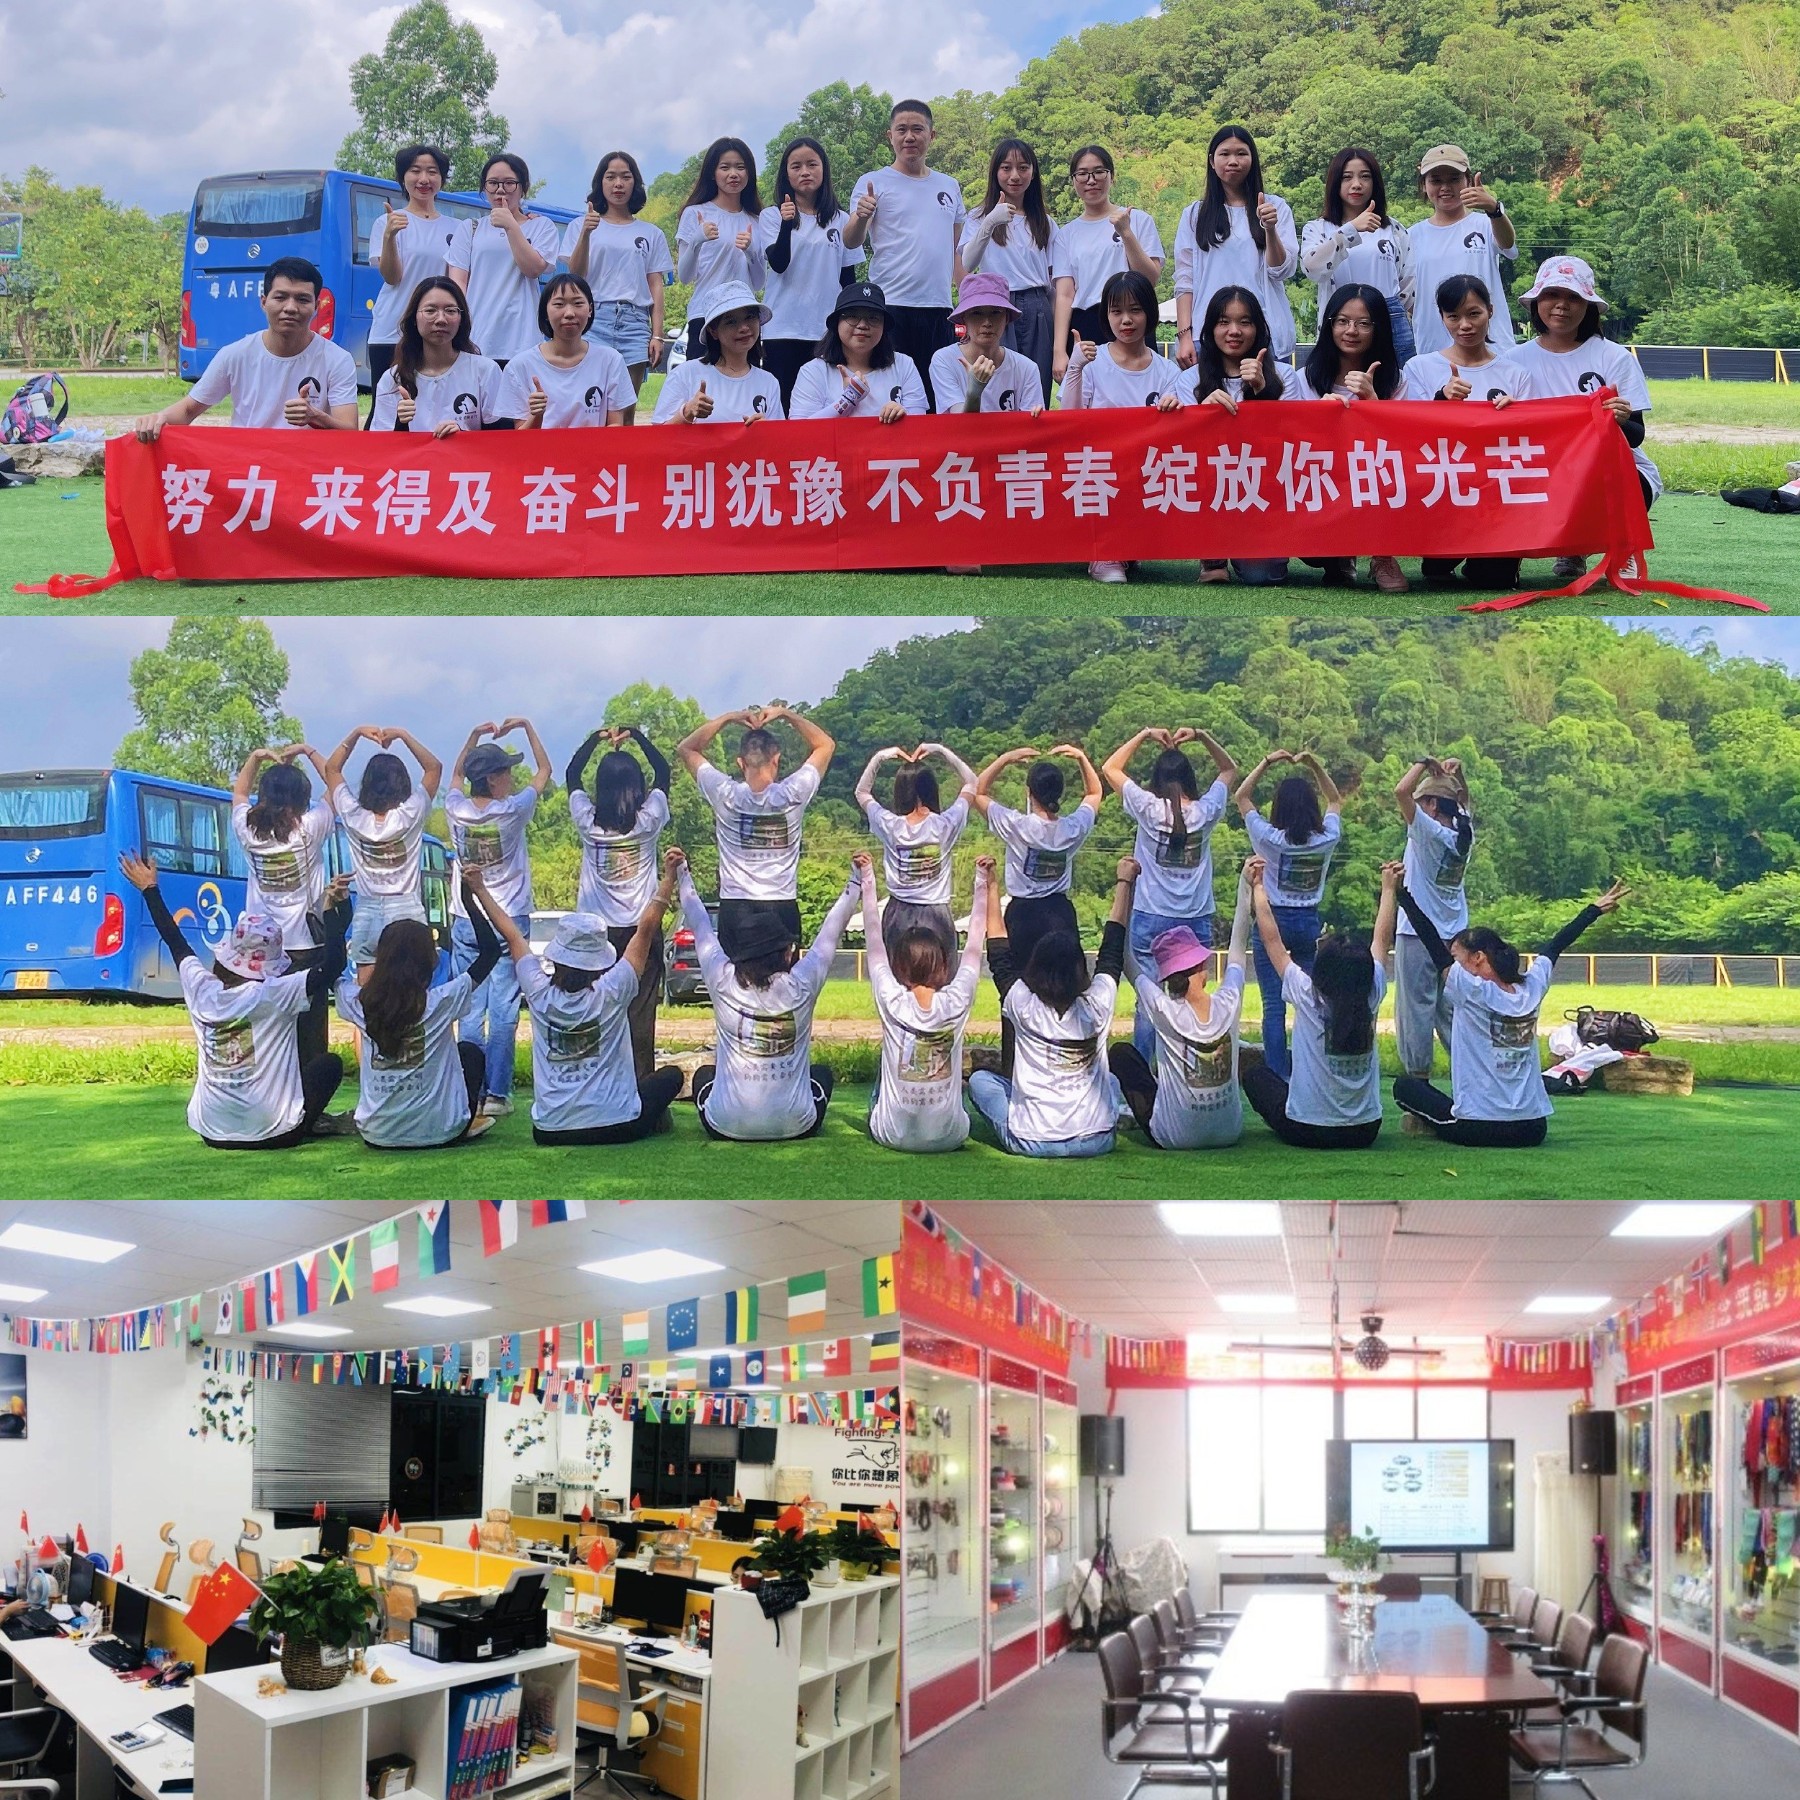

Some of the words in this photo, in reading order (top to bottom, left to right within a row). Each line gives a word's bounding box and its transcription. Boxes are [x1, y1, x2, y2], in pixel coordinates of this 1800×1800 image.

[162, 464, 277, 534] 努力
[300, 467, 496, 535] 来得及
[521, 465, 639, 533] 奋斗
[662, 457, 846, 529] 别犹豫
[867, 447, 1119, 522] 不负青春
[1141, 437, 1549, 513] 绽放你的光芒
[6, 885, 98, 905] AFF446
[832, 1467, 899, 1482] 你比你想象
